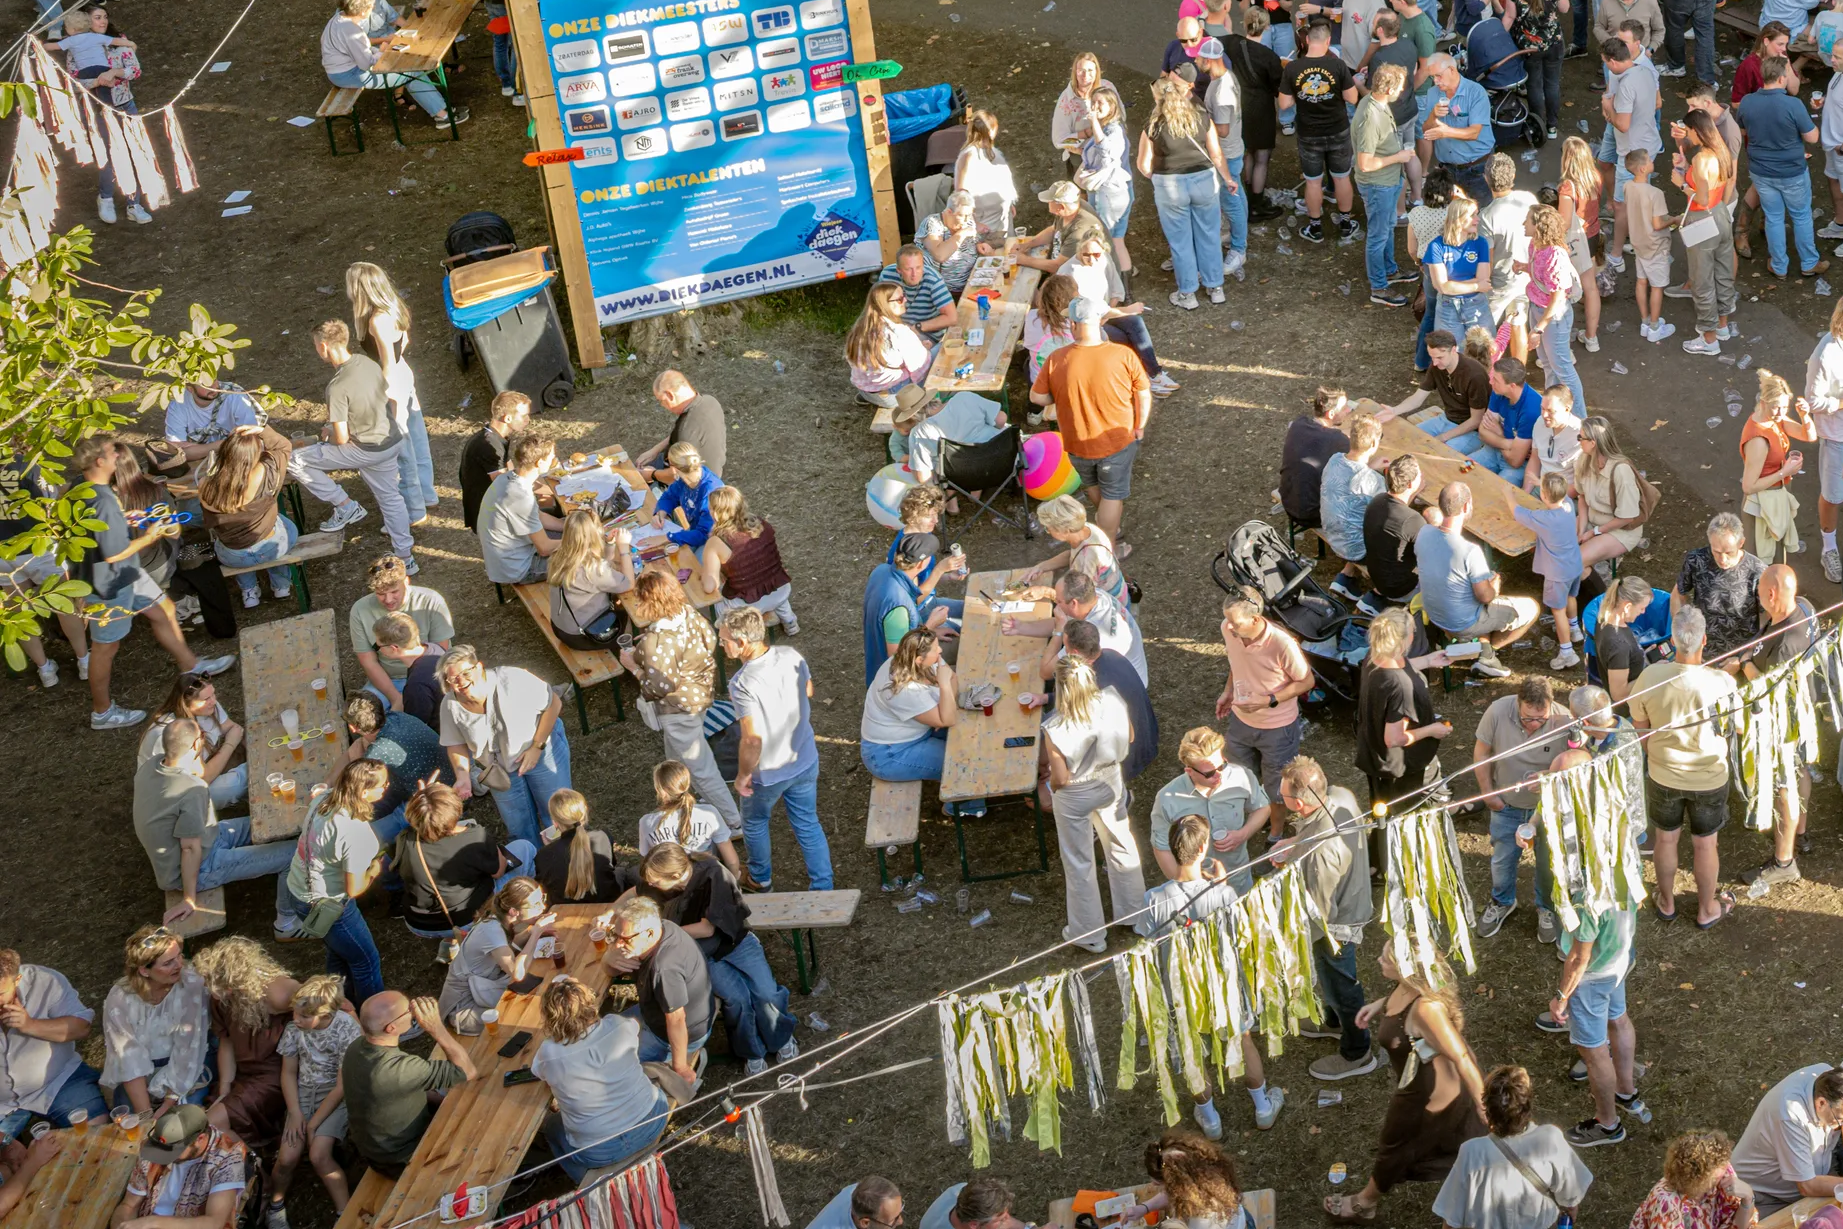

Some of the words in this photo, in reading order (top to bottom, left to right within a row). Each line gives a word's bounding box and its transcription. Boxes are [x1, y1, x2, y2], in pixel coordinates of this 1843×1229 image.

[549, 17, 601, 38] ONZE
[812, 66, 826, 76] UW
[847, 69, 861, 80] Oh
[1304, 67, 1321, 75] GREAT
[1321, 69, 1336, 86] ESCAPE
[565, 80, 600, 98] ARVA
[536, 153, 577, 166] Relax
[586, 146, 613, 157] ents
[580, 183, 631, 204] ONZE
[635, 158, 766, 196] DIEKTALENTEN
[808, 229, 858, 250] daegen
[815, 225, 844, 240] diek
[600, 263, 796, 316] WWW.DIEKDAEGEN.NL
